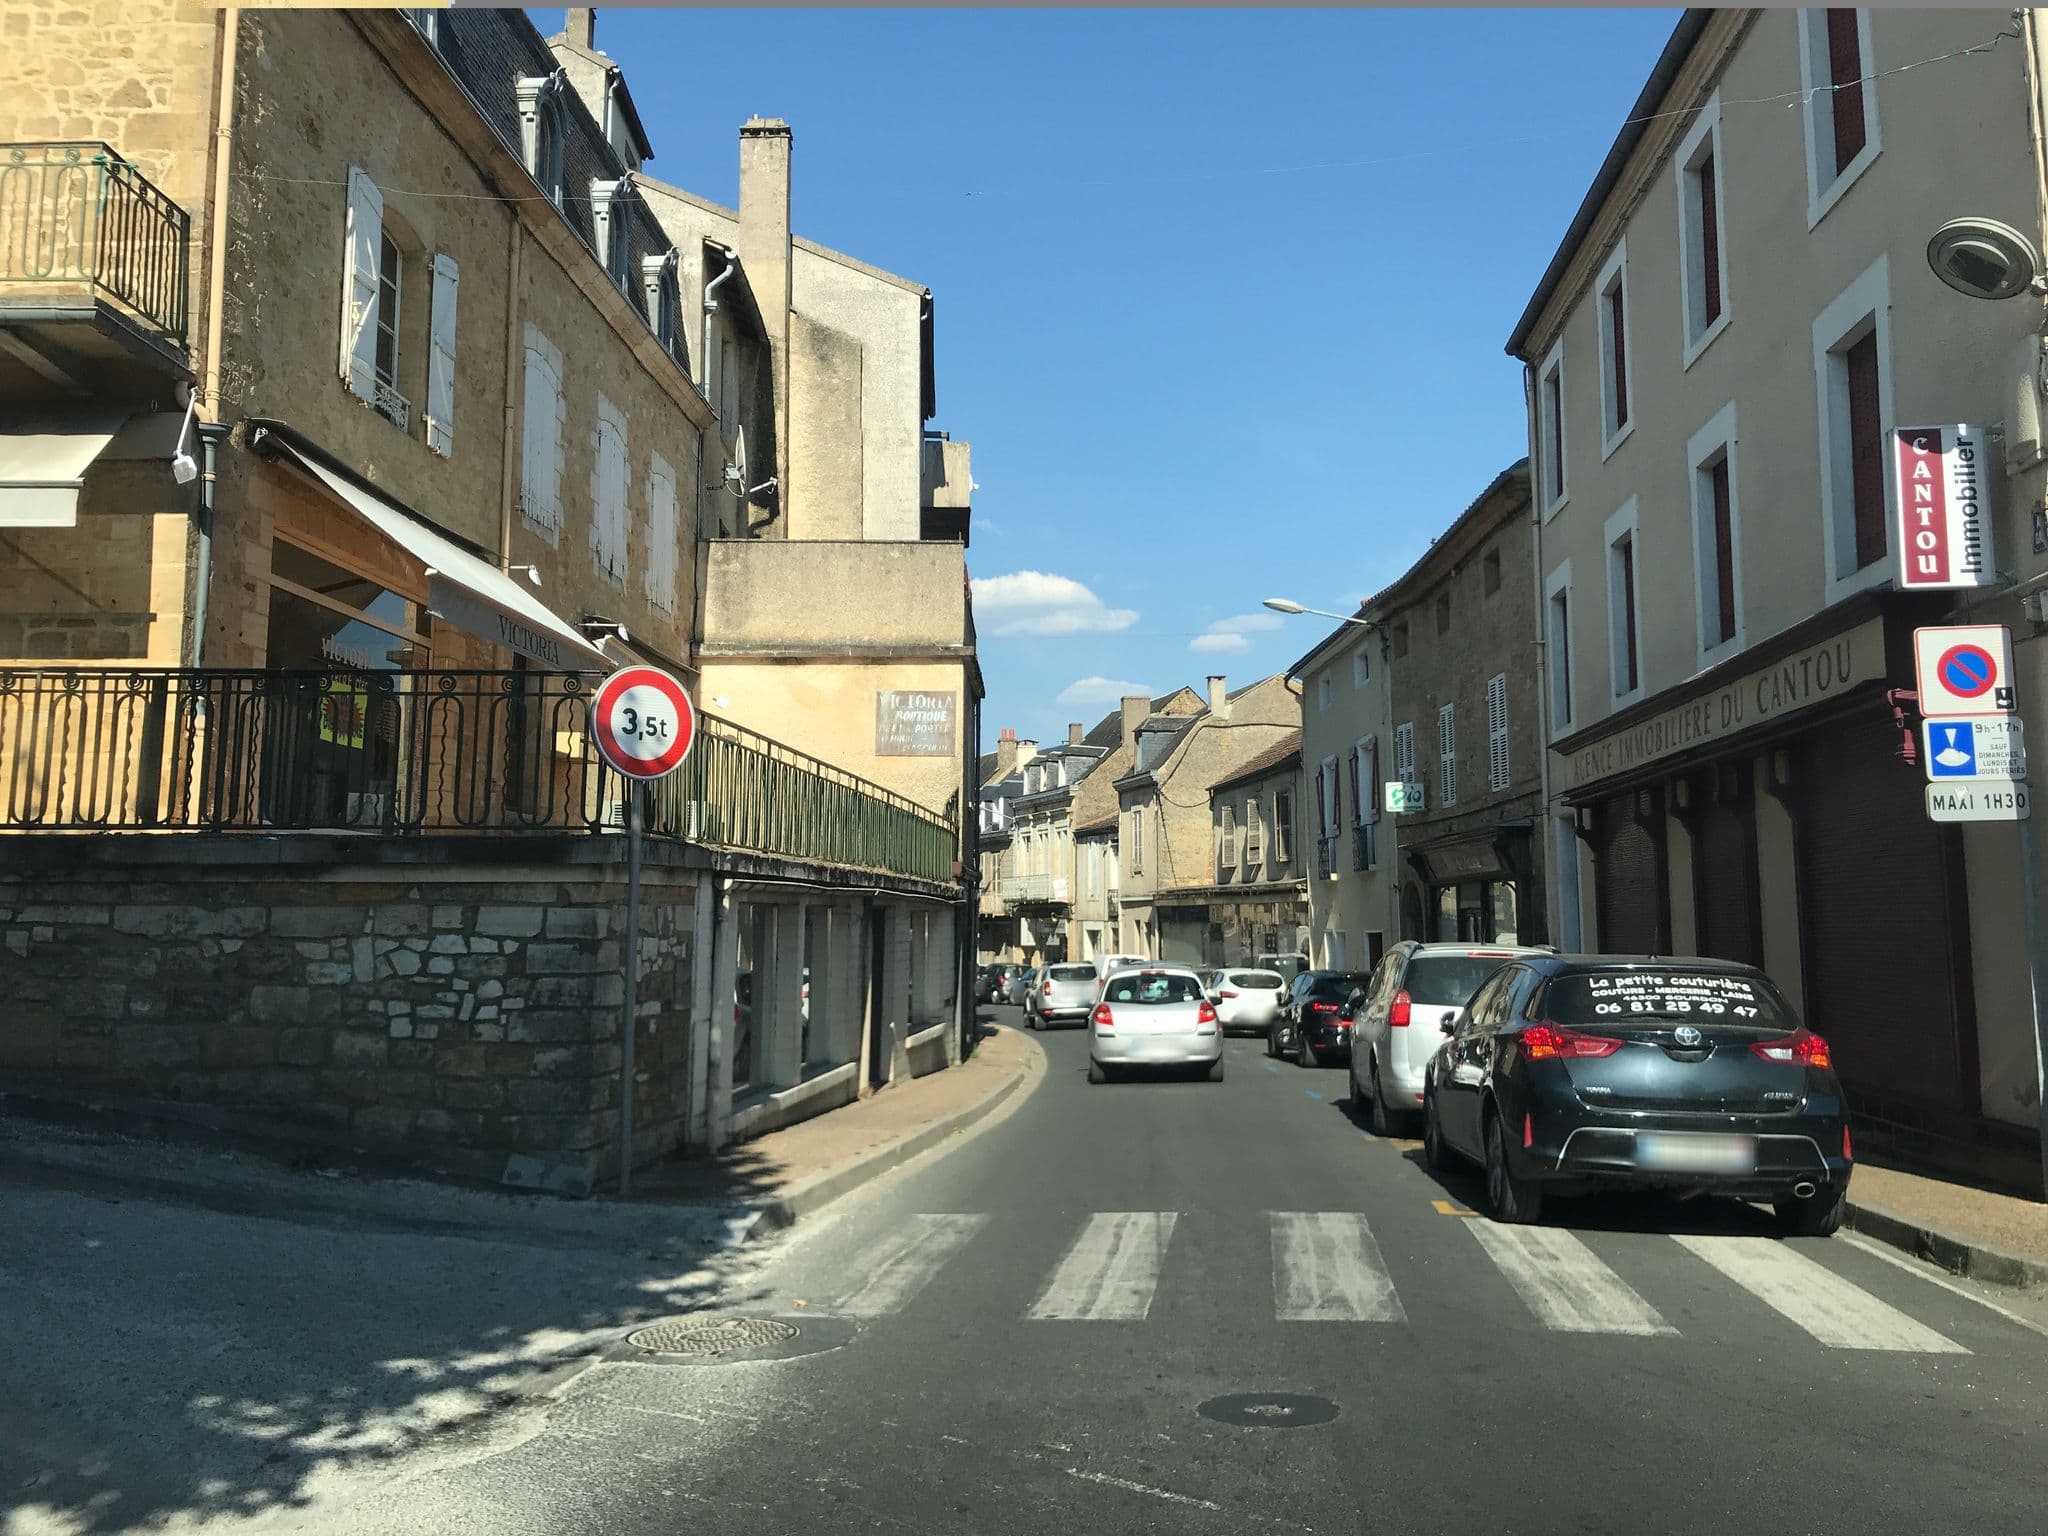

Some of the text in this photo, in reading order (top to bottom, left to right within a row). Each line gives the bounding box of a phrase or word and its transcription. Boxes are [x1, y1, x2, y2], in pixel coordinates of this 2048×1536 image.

[1912, 437, 1938, 574] CANTOU
[1954, 437, 1982, 573] Immobilier
[497, 614, 560, 665] VICTORIA
[1573, 742, 1613, 783] AGENCE
[1721, 686, 1743, 729] DU
[1757, 639, 1851, 714] CANTOU
[2008, 758, 2018, 767] ET
[1933, 793, 2026, 810] MAXI 1H30
[1589, 975, 1752, 992] La petite couturière
[1591, 987, 1646, 997] COUTURE
[1655, 987, 1711, 996] MERCERIE
[1665, 994, 1728, 1004] GOURDON
[1595, 1001, 1758, 1018] 06 81 25 49 47
